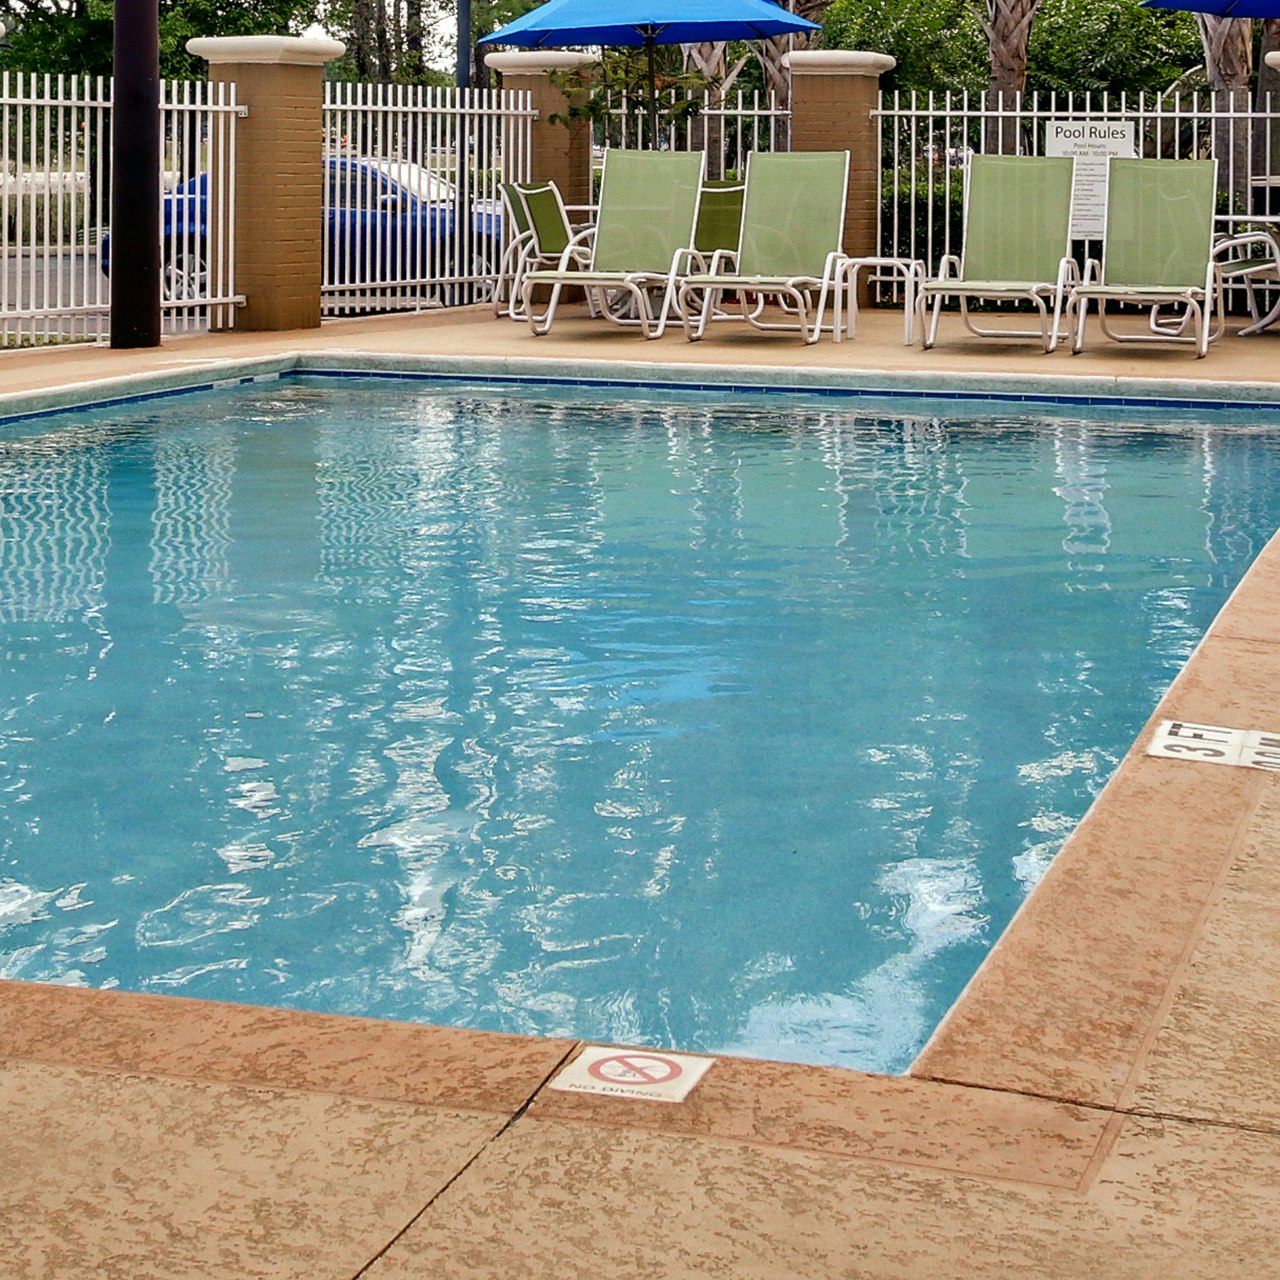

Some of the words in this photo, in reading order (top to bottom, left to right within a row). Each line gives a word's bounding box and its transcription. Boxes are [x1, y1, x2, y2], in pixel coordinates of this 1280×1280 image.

[1055, 126, 1085, 138] Pool
[1089, 126, 1126, 139] Rules
[1167, 722, 1233, 744] FT
[1163, 743, 1226, 758] 3
